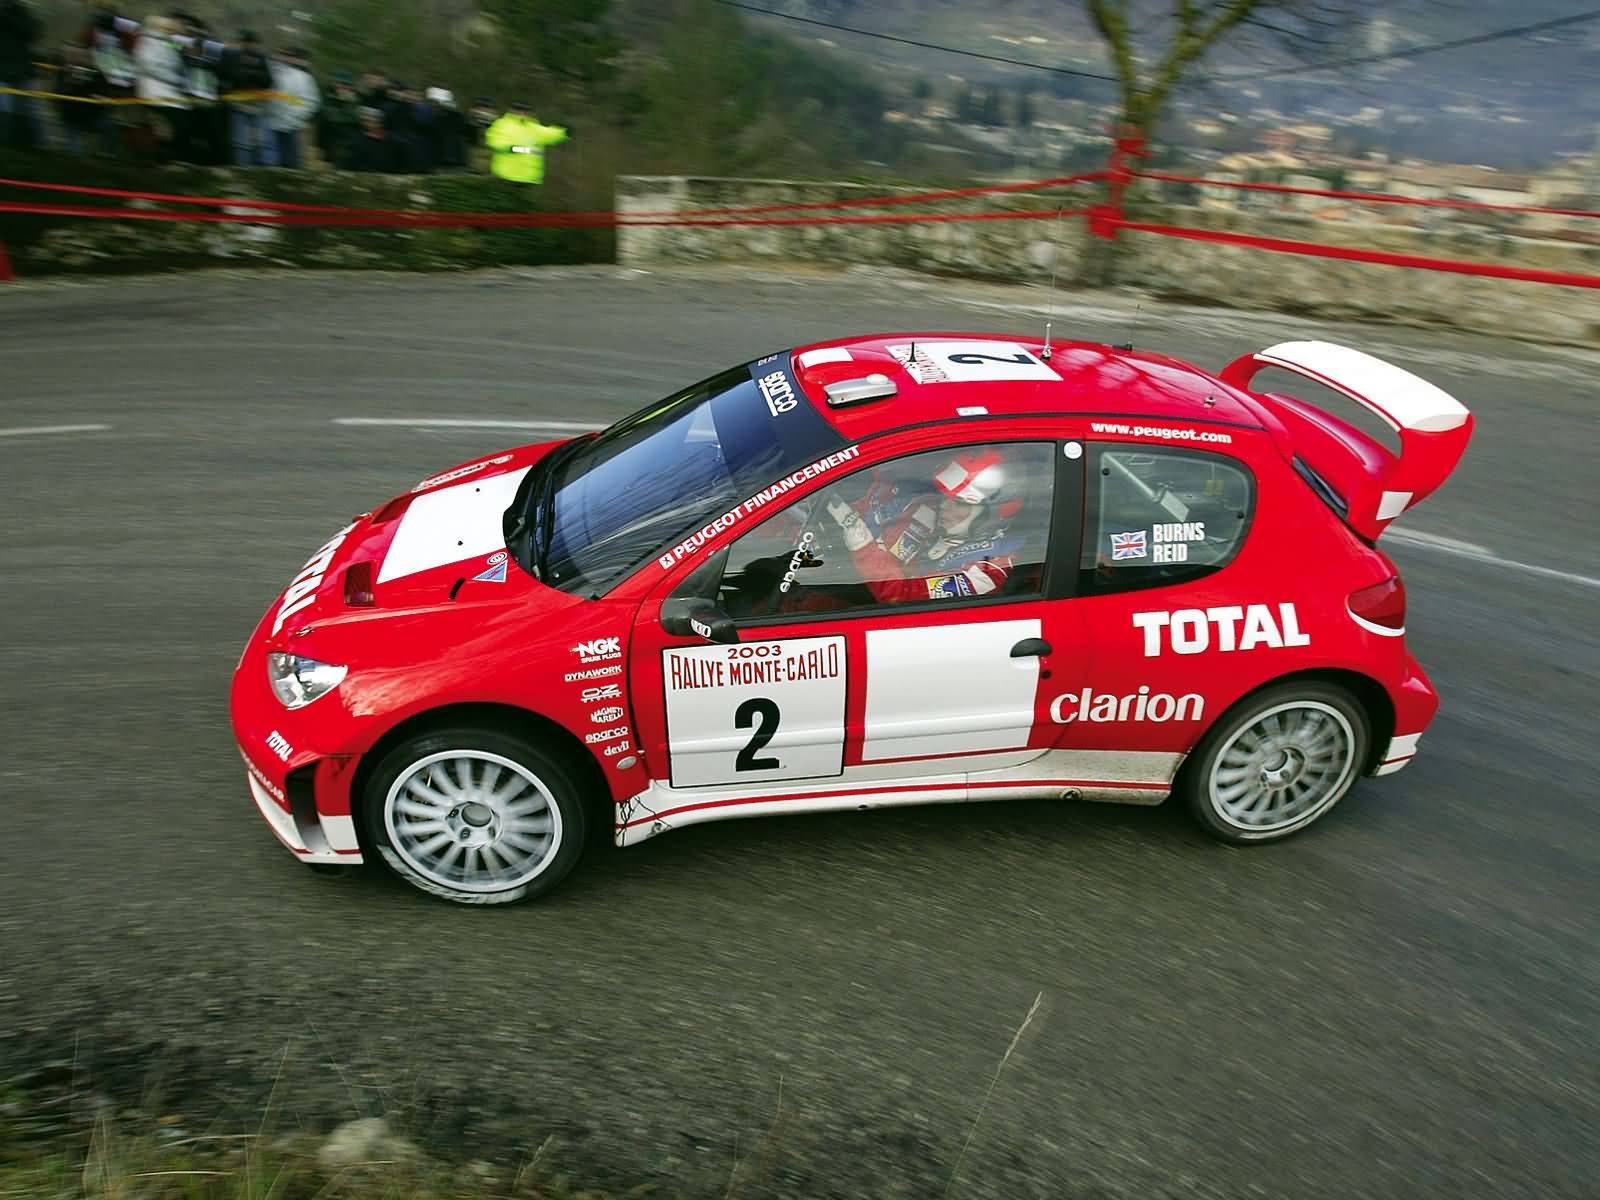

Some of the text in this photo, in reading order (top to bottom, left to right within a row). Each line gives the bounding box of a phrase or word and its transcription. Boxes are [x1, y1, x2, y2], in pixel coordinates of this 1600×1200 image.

[758, 370, 798, 417] sparco
[1091, 422, 1232, 444] www.peugeot.com
[673, 445, 861, 560] PEUGEOT FINANCEMENT
[1152, 521, 1206, 543] BURNS
[1152, 543, 1188, 563] REID
[1132, 602, 1311, 657] TOTAL
[574, 636, 621, 658] NGK
[727, 645, 782, 660] 2003
[564, 665, 623, 682] DYNAWORK
[670, 654, 724, 690] RALLYE
[1050, 685, 1205, 724] clarion
[265, 730, 294, 763] TOTAL
[585, 726, 629, 743] sparco
[734, 697, 781, 772] 2
